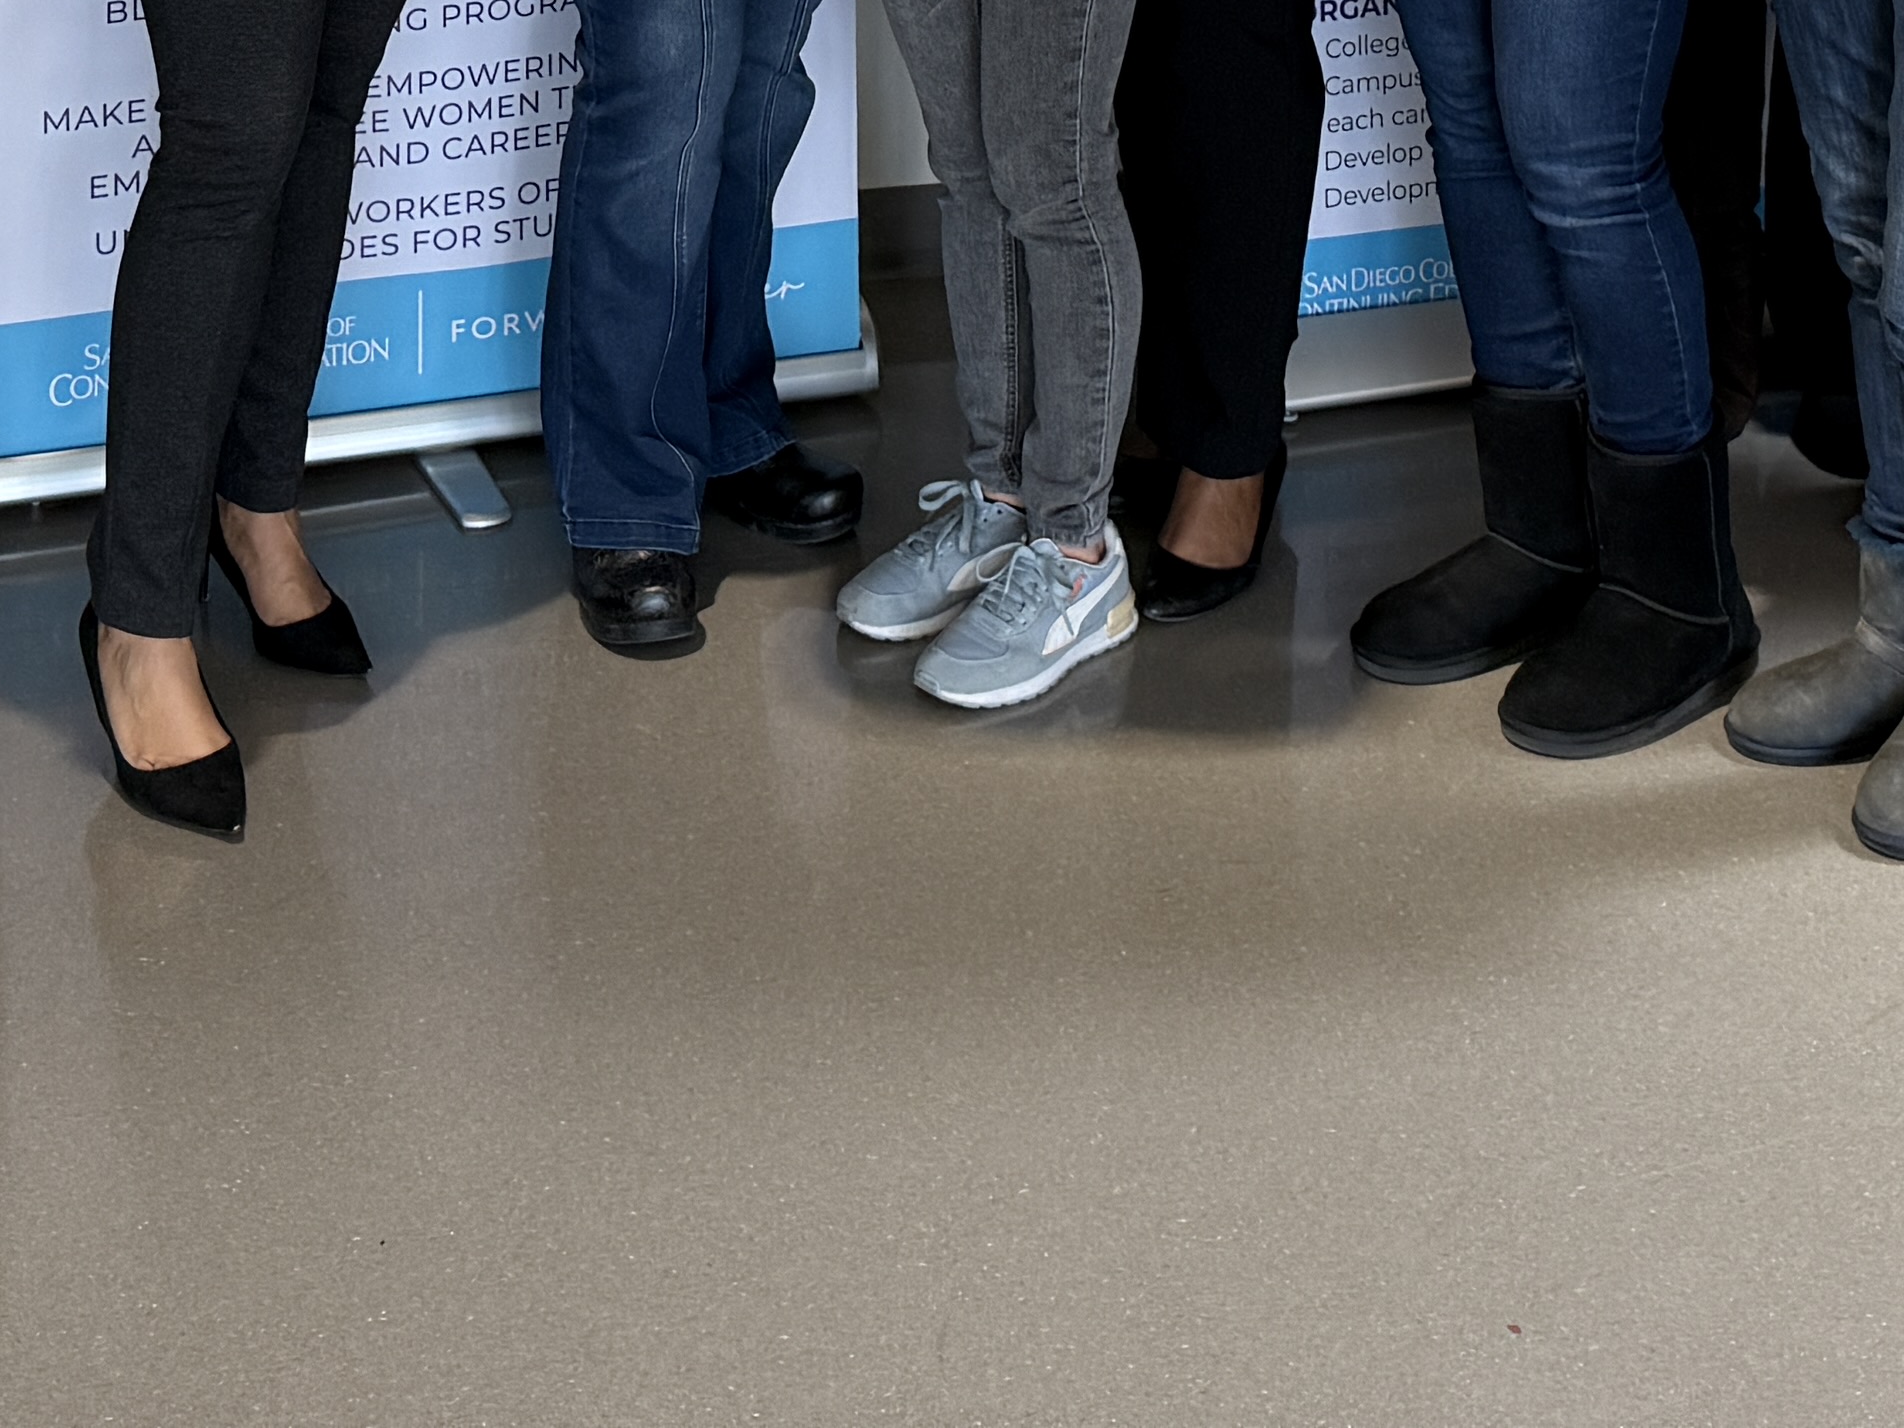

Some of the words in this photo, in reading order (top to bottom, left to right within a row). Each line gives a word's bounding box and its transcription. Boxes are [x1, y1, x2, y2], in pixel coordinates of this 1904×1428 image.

[43, 99, 147, 134] MAKE
[403, 90, 539, 130] WOMEN
[1327, 106, 1383, 133] each
[1325, 142, 1422, 171] Develop
[414, 225, 481, 254] FOR
[1304, 272, 1346, 298] SAN
[1352, 265, 1414, 291] DIEGO
[327, 317, 356, 337] OF
